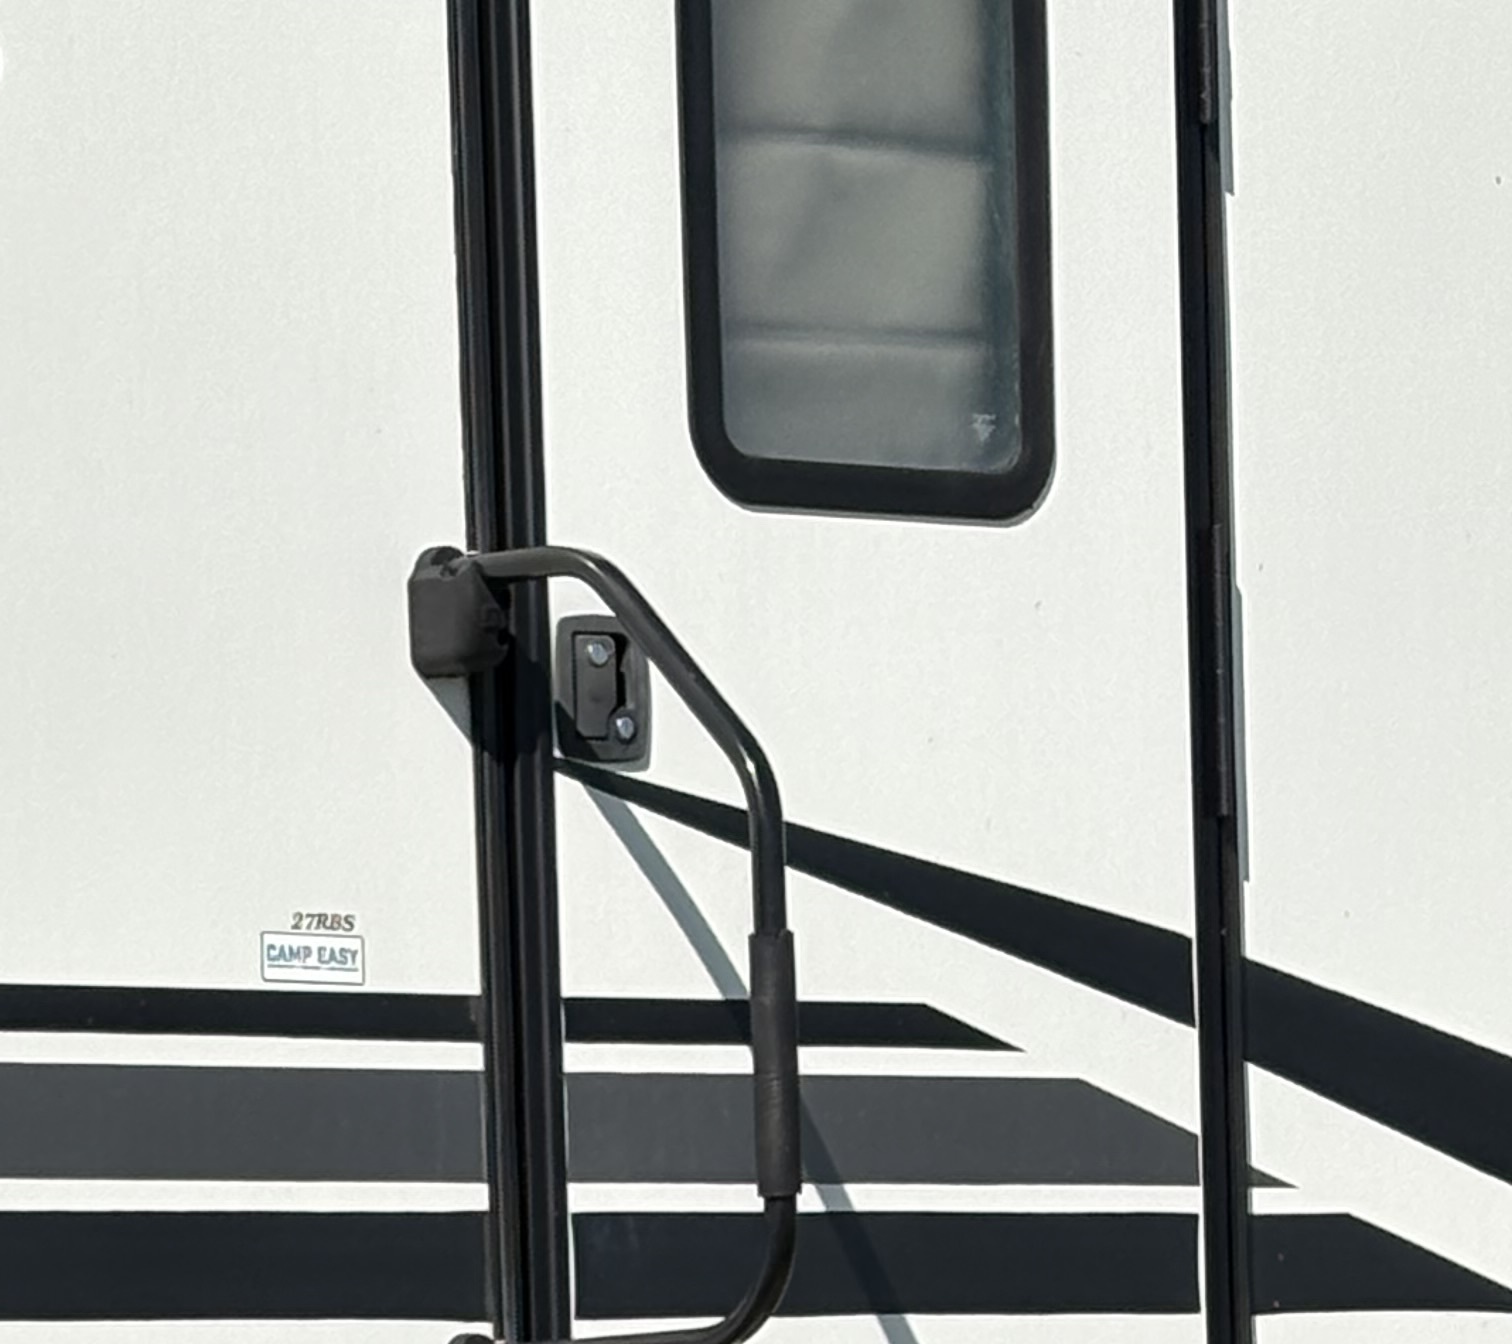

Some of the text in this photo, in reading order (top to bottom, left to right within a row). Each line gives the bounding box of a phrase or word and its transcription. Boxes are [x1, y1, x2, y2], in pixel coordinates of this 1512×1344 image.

[290, 911, 356, 932] 27RBS
[267, 944, 358, 966] CAMP EASY
